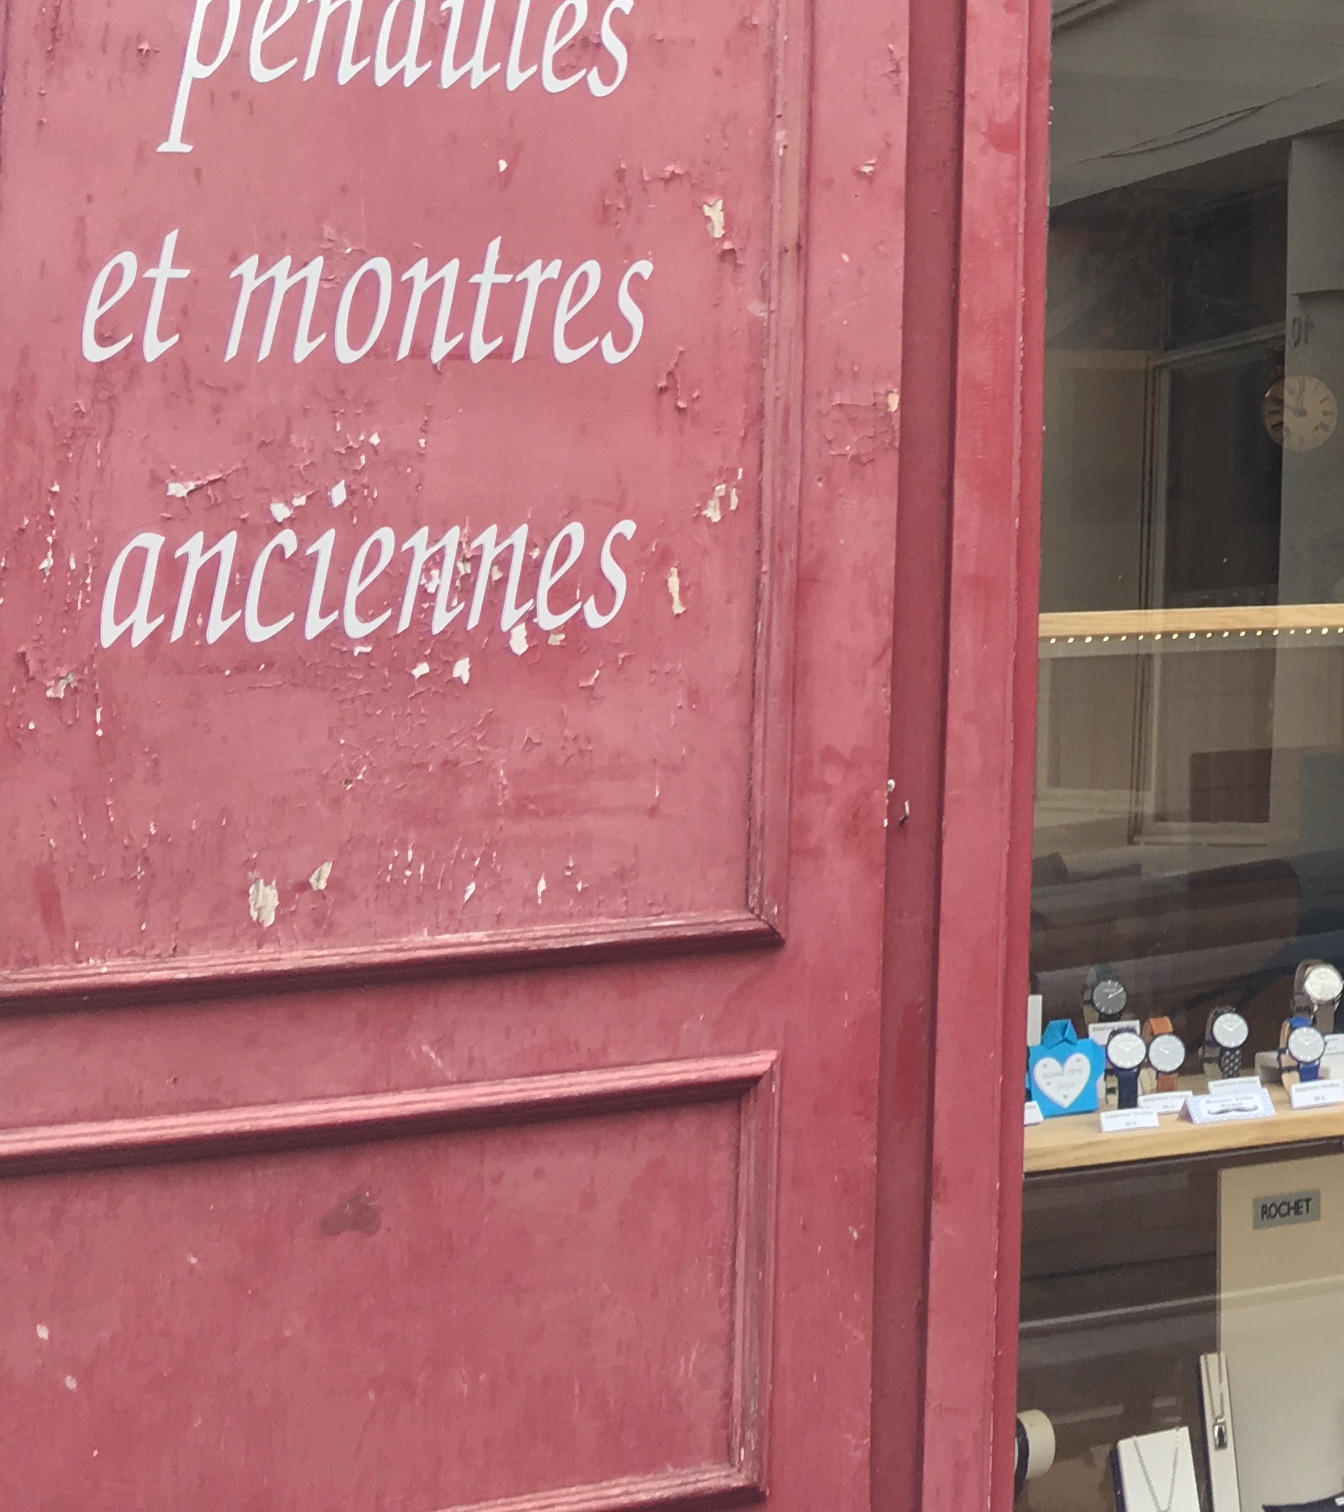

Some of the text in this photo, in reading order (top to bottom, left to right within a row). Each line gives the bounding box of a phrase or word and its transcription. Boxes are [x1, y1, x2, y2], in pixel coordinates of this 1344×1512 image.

[82, 228, 654, 365] et montres
[100, 480, 637, 649] anciennes
[1260, 1198, 1312, 1220] ROCHET
